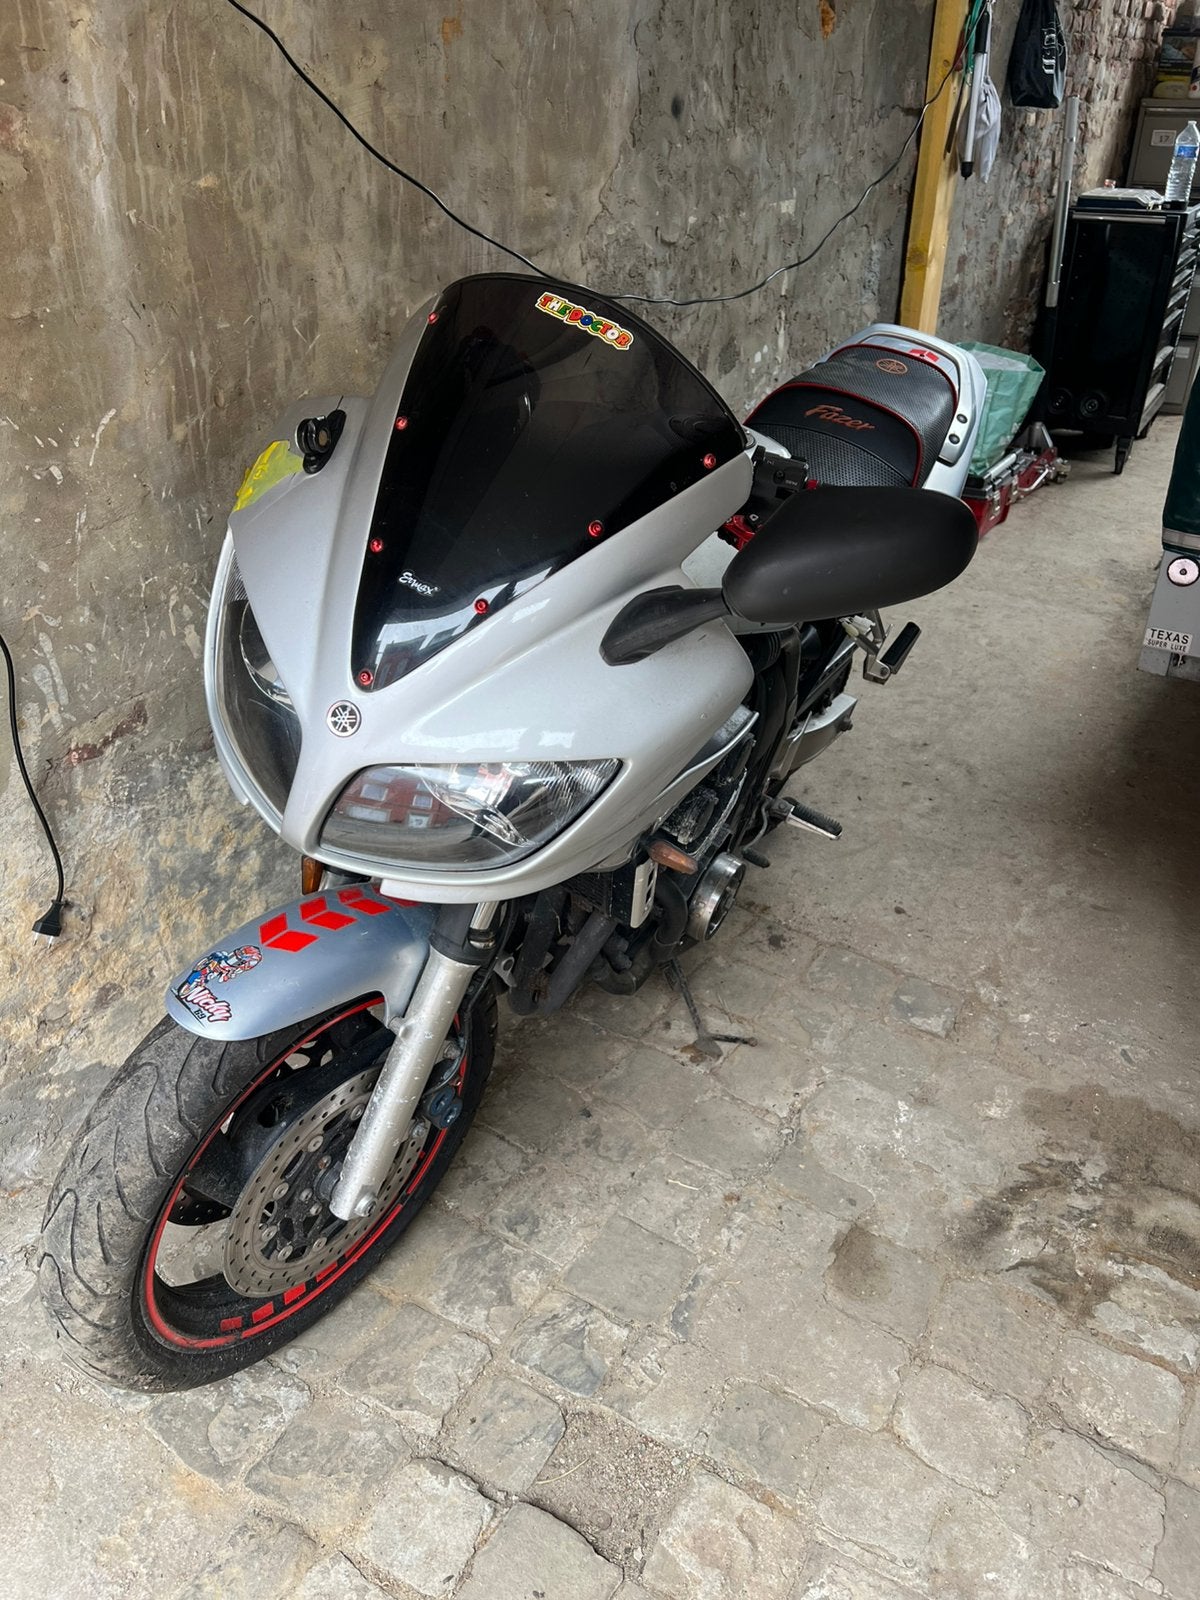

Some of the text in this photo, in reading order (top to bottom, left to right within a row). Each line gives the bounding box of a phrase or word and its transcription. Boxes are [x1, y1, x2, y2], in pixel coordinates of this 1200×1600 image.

[539, 295, 631, 347] THE DOCTOR
[805, 404, 875, 430] Fazer
[1147, 638, 1187, 653] SUPER LUXE
[1150, 628, 1189, 645] TEXAS
